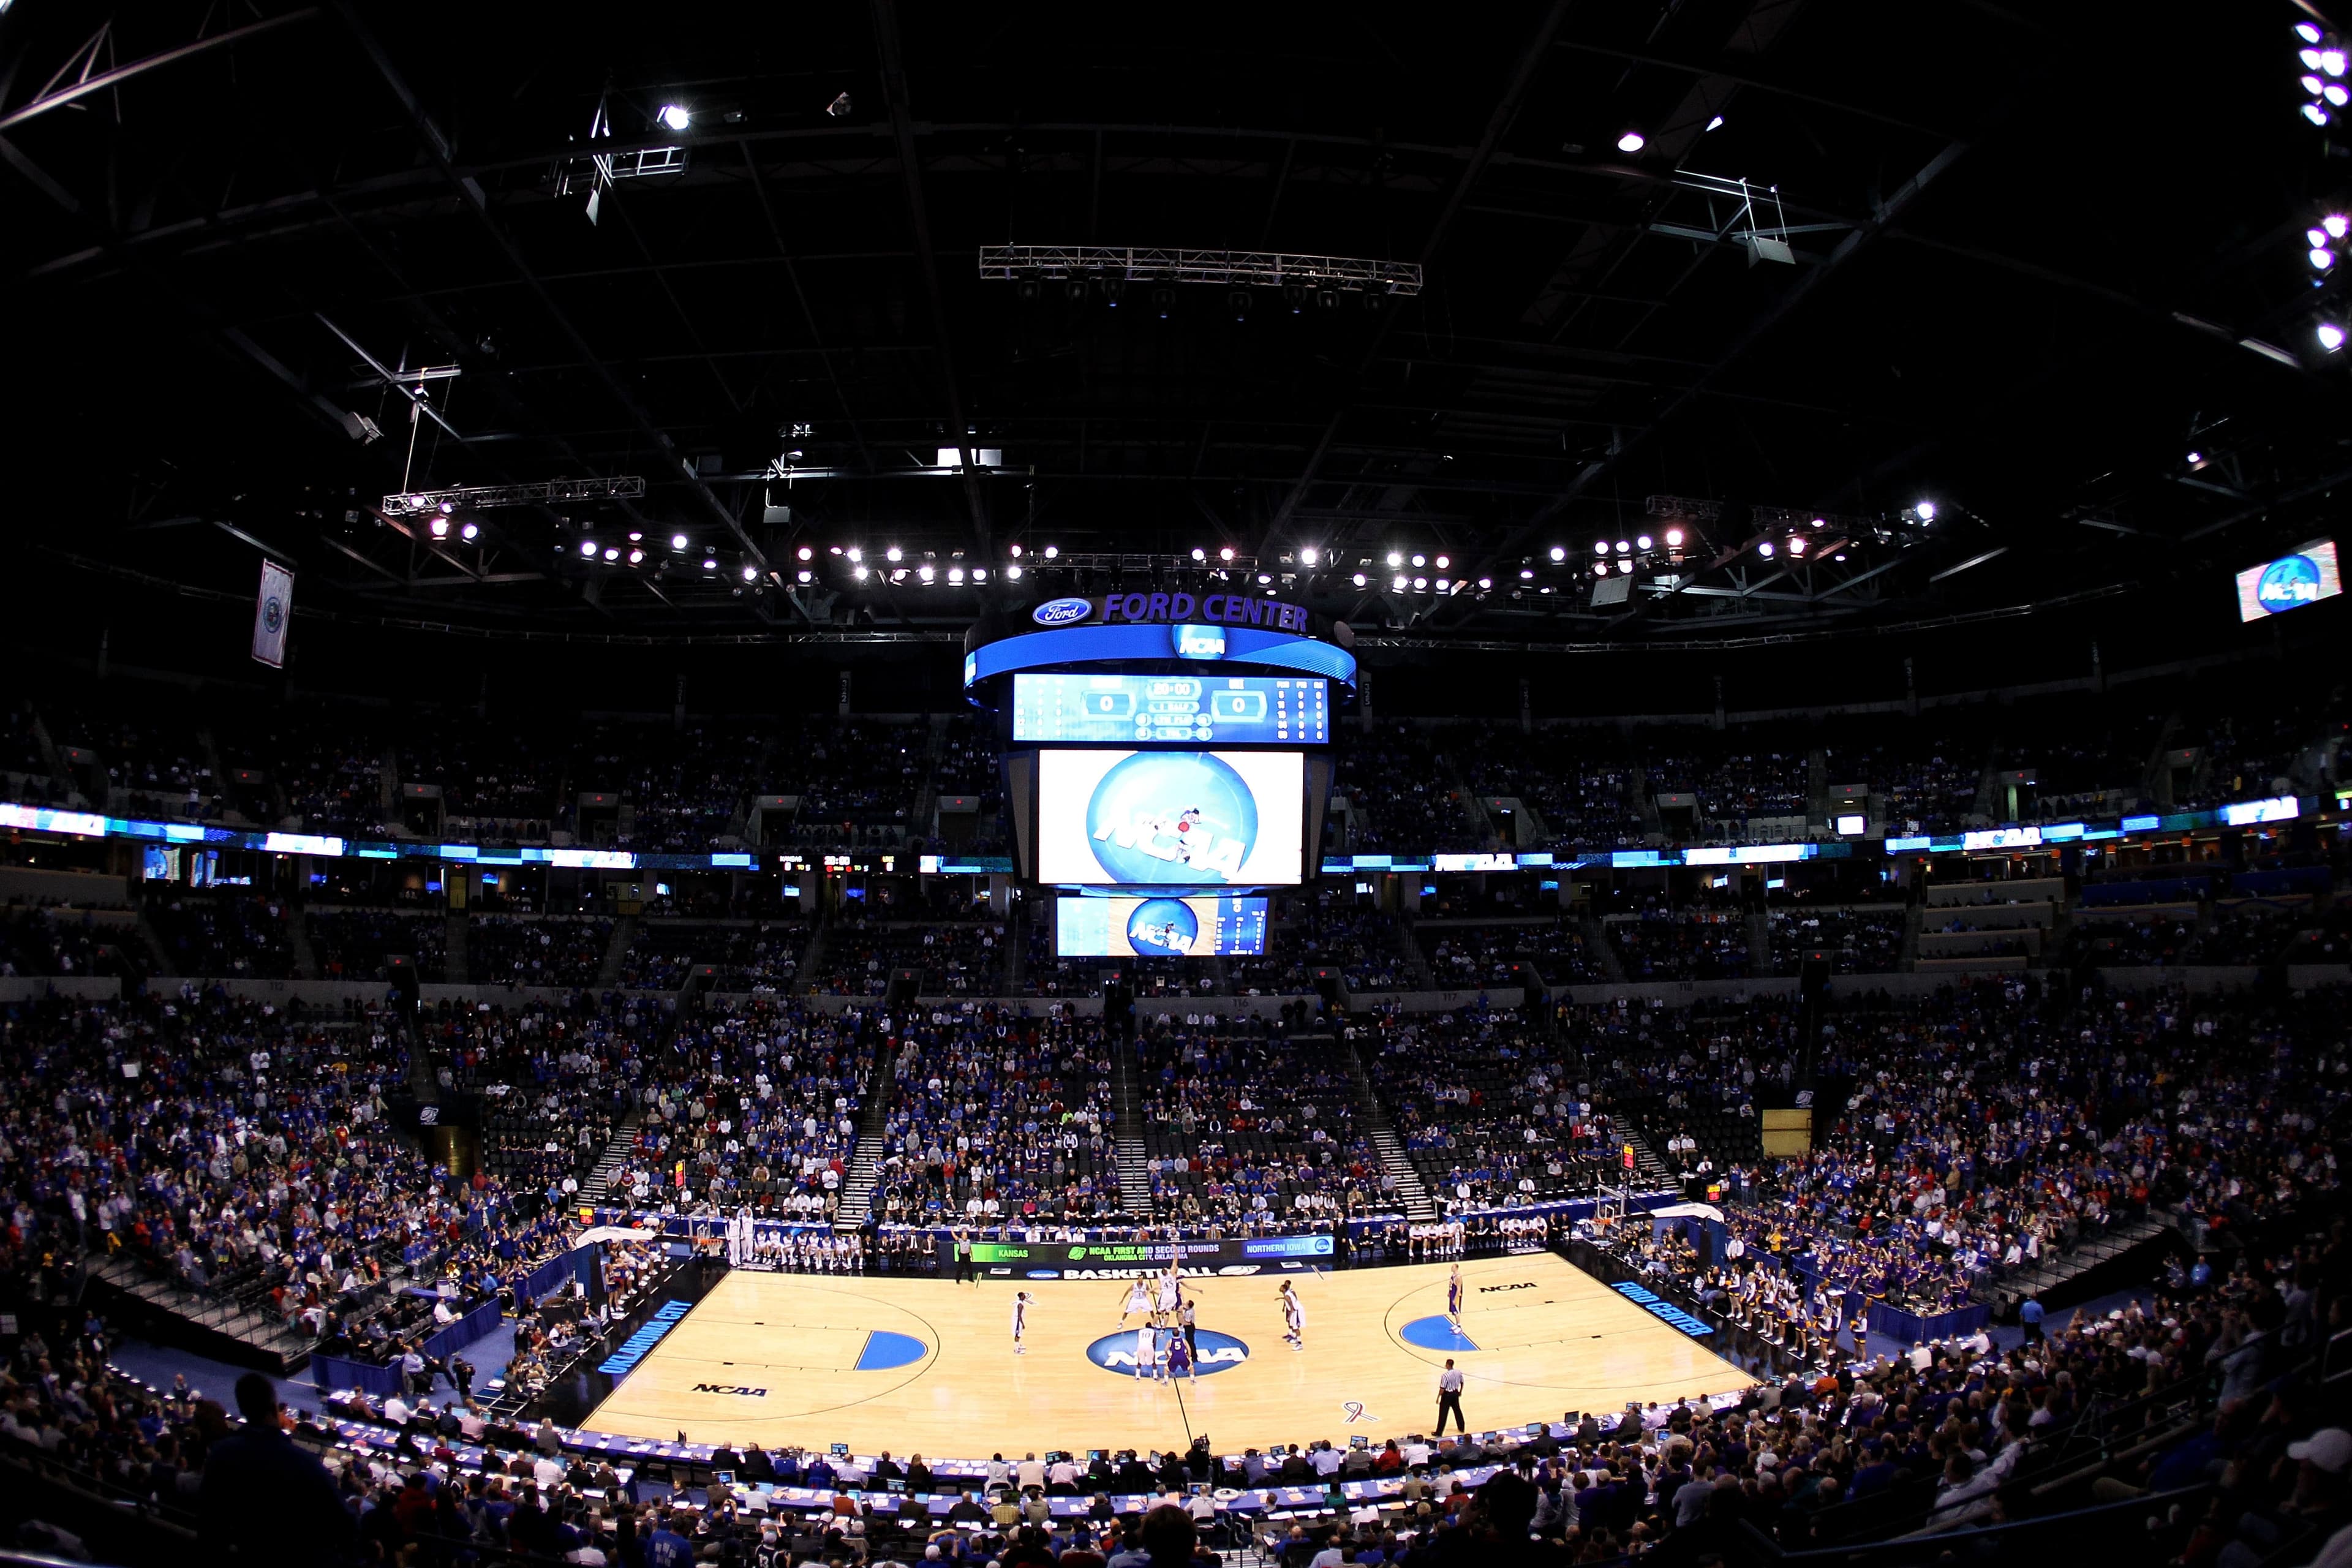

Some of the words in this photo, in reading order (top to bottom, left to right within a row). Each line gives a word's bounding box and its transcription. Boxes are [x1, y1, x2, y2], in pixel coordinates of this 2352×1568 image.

[1045, 603, 1079, 620] Ford
[1102, 592, 1194, 621] FORD
[1203, 594, 1308, 632] CENTER
[1179, 638, 1225, 654] NCAA
[1099, 695, 1114, 712] 0
[1232, 697, 1246, 713] 0
[1129, 921, 1193, 954] NCAA
[998, 1249, 1028, 1258] KANSAS
[1089, 1246, 1111, 1255] NCAA
[1137, 1246, 1153, 1254] AND
[1188, 1244, 1219, 1253] ROUNDS
[1246, 1244, 1286, 1253] NORTHERN
[1164, 1280, 1174, 1289] 45
[1479, 1282, 1539, 1292] NCAA
[1610, 1282, 1660, 1303] FORD
[1646, 1302, 1714, 1336] CENTER
[598, 1321, 674, 1374] OKLAHOMA
[654, 1299, 693, 1320] CITY
[1174, 1341, 1182, 1350] 5
[692, 1383, 767, 1397] NCAA
